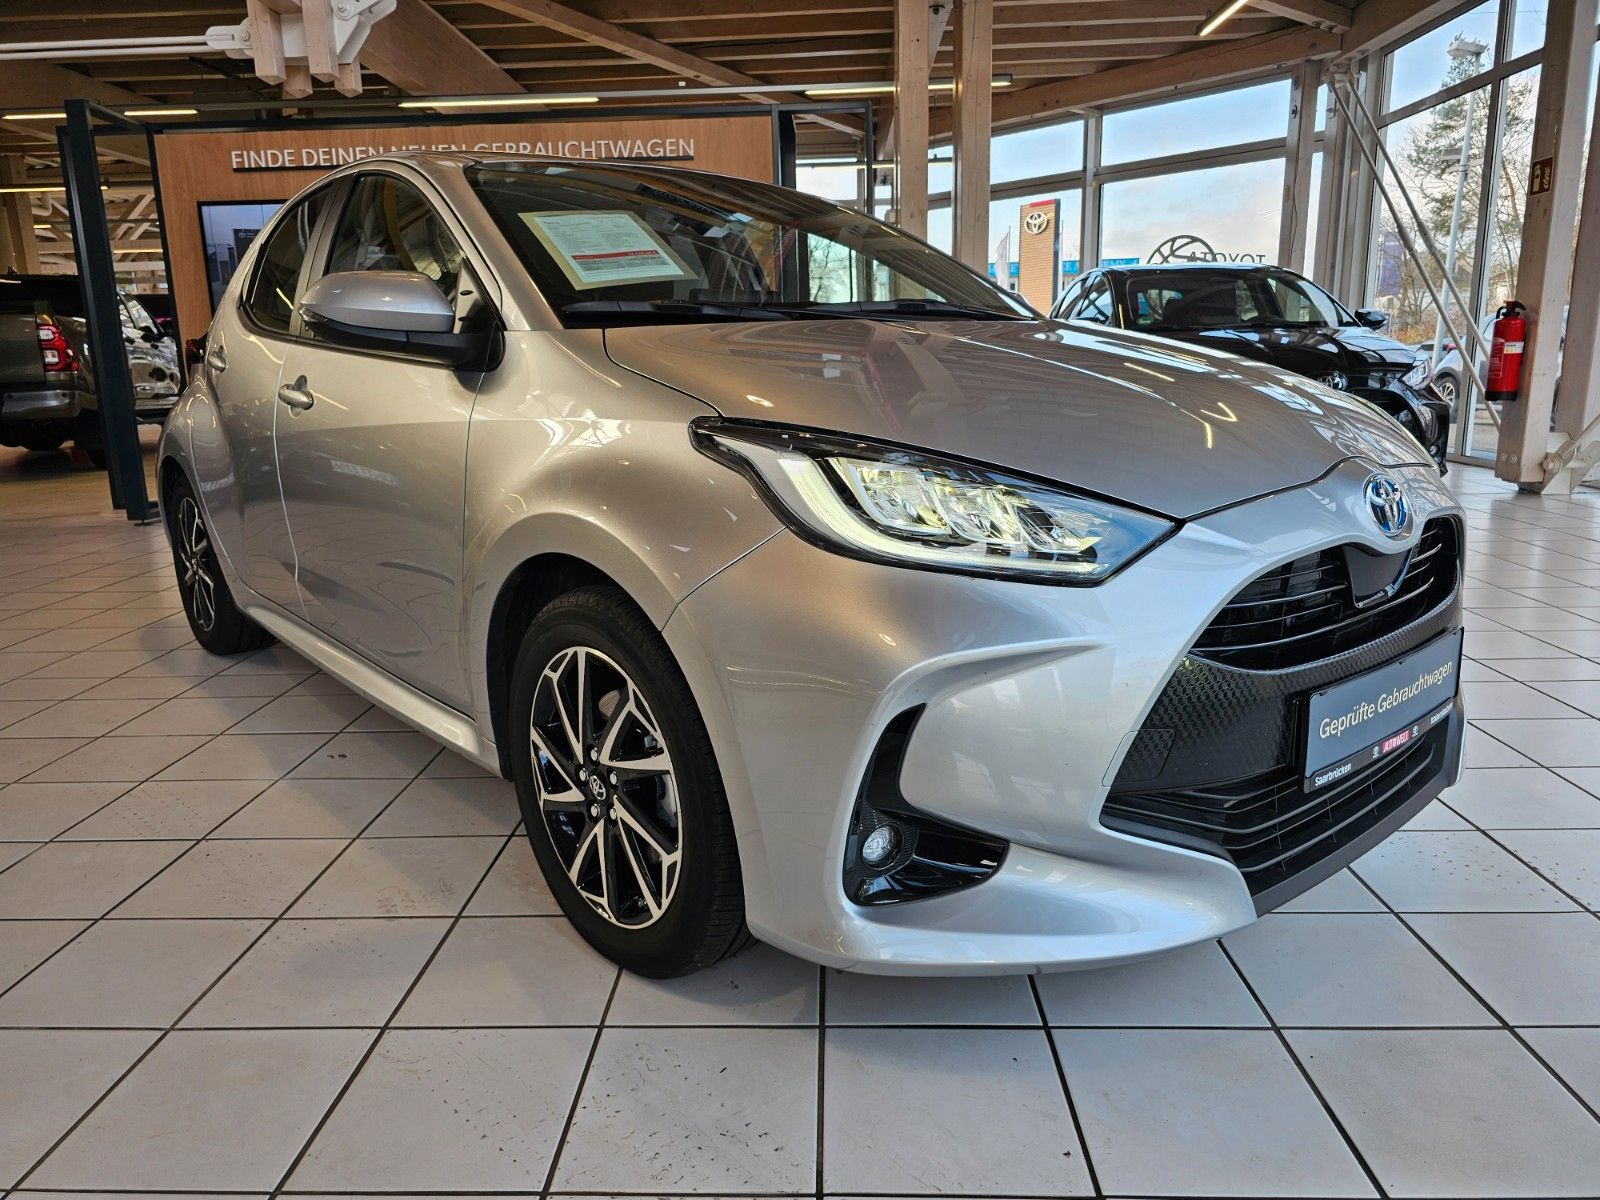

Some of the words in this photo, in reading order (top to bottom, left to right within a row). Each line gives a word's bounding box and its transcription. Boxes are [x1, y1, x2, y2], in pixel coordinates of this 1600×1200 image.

[231, 148, 295, 169] FINDE
[1319, 701, 1375, 739] Geprüfte
[1377, 661, 1452, 713] Gebrauchtwagen
[1315, 762, 1352, 786] Saarbrücken
